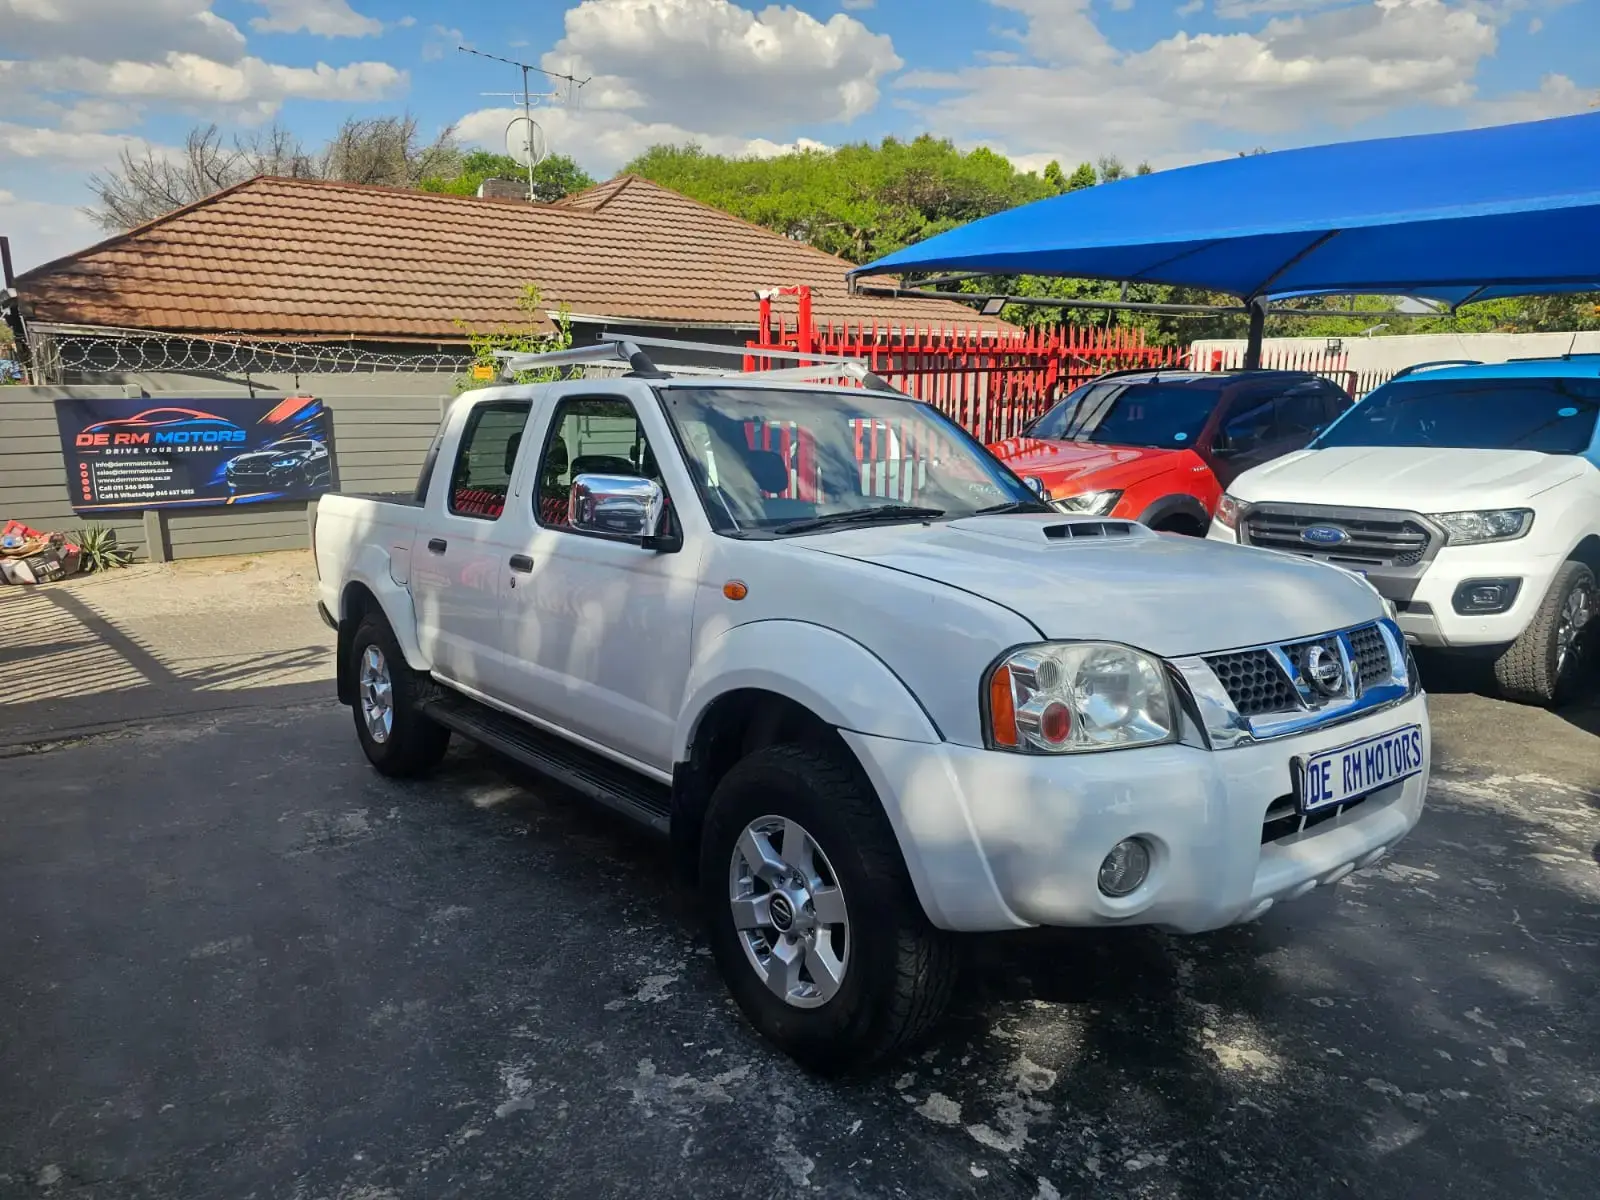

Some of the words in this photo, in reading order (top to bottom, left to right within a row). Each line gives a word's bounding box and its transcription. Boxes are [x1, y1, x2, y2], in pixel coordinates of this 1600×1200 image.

[75, 433, 110, 446] DE
[114, 433, 150, 445] RM
[155, 430, 247, 444] MOTORS
[105, 447, 139, 455] DRIVE
[177, 445, 219, 453] DREAMS
[1309, 759, 1333, 805] DE
[1342, 750, 1363, 794] RM
[1364, 730, 1421, 786] MOTORS
